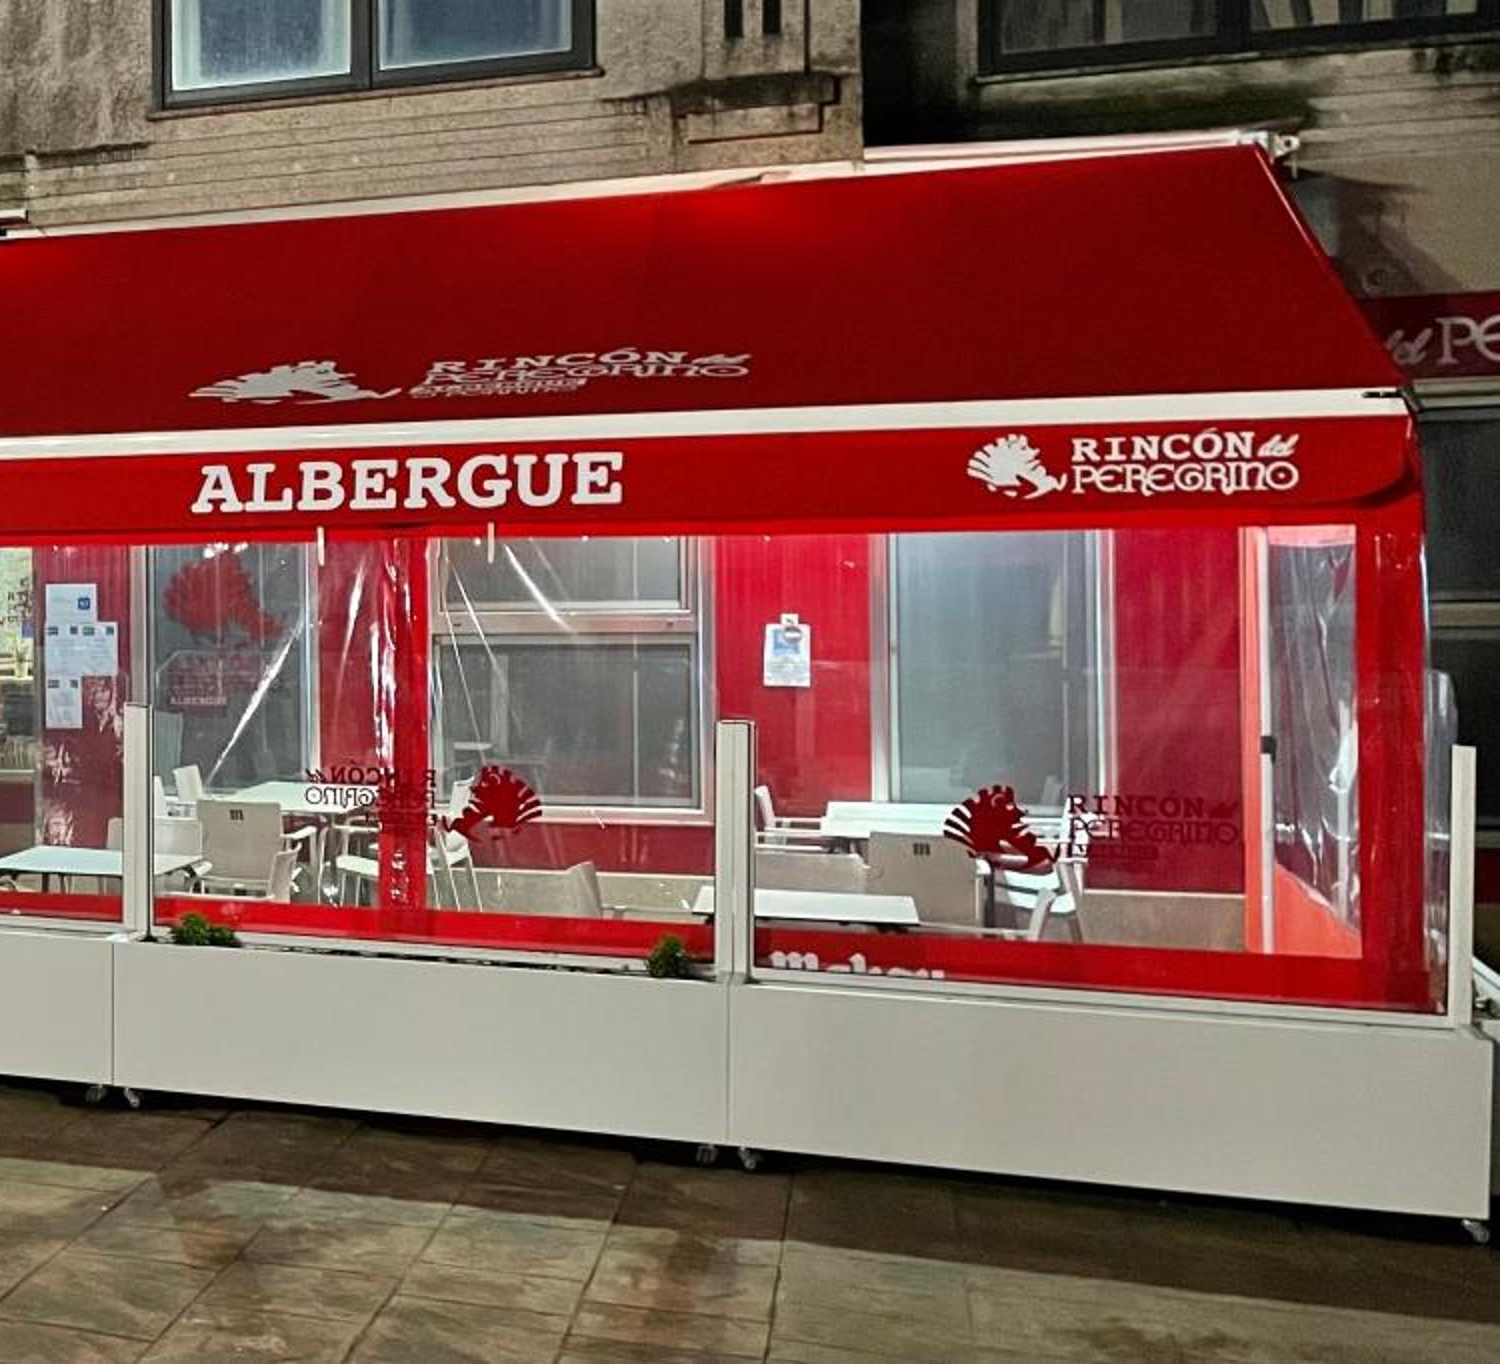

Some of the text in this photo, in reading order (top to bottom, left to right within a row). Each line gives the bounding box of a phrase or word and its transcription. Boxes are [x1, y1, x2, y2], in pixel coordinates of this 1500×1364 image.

[1071, 428, 1255, 462] RINCÓN
[191, 451, 624, 514] ALBERGUE
[1071, 461, 1299, 496] PEREGRINO
